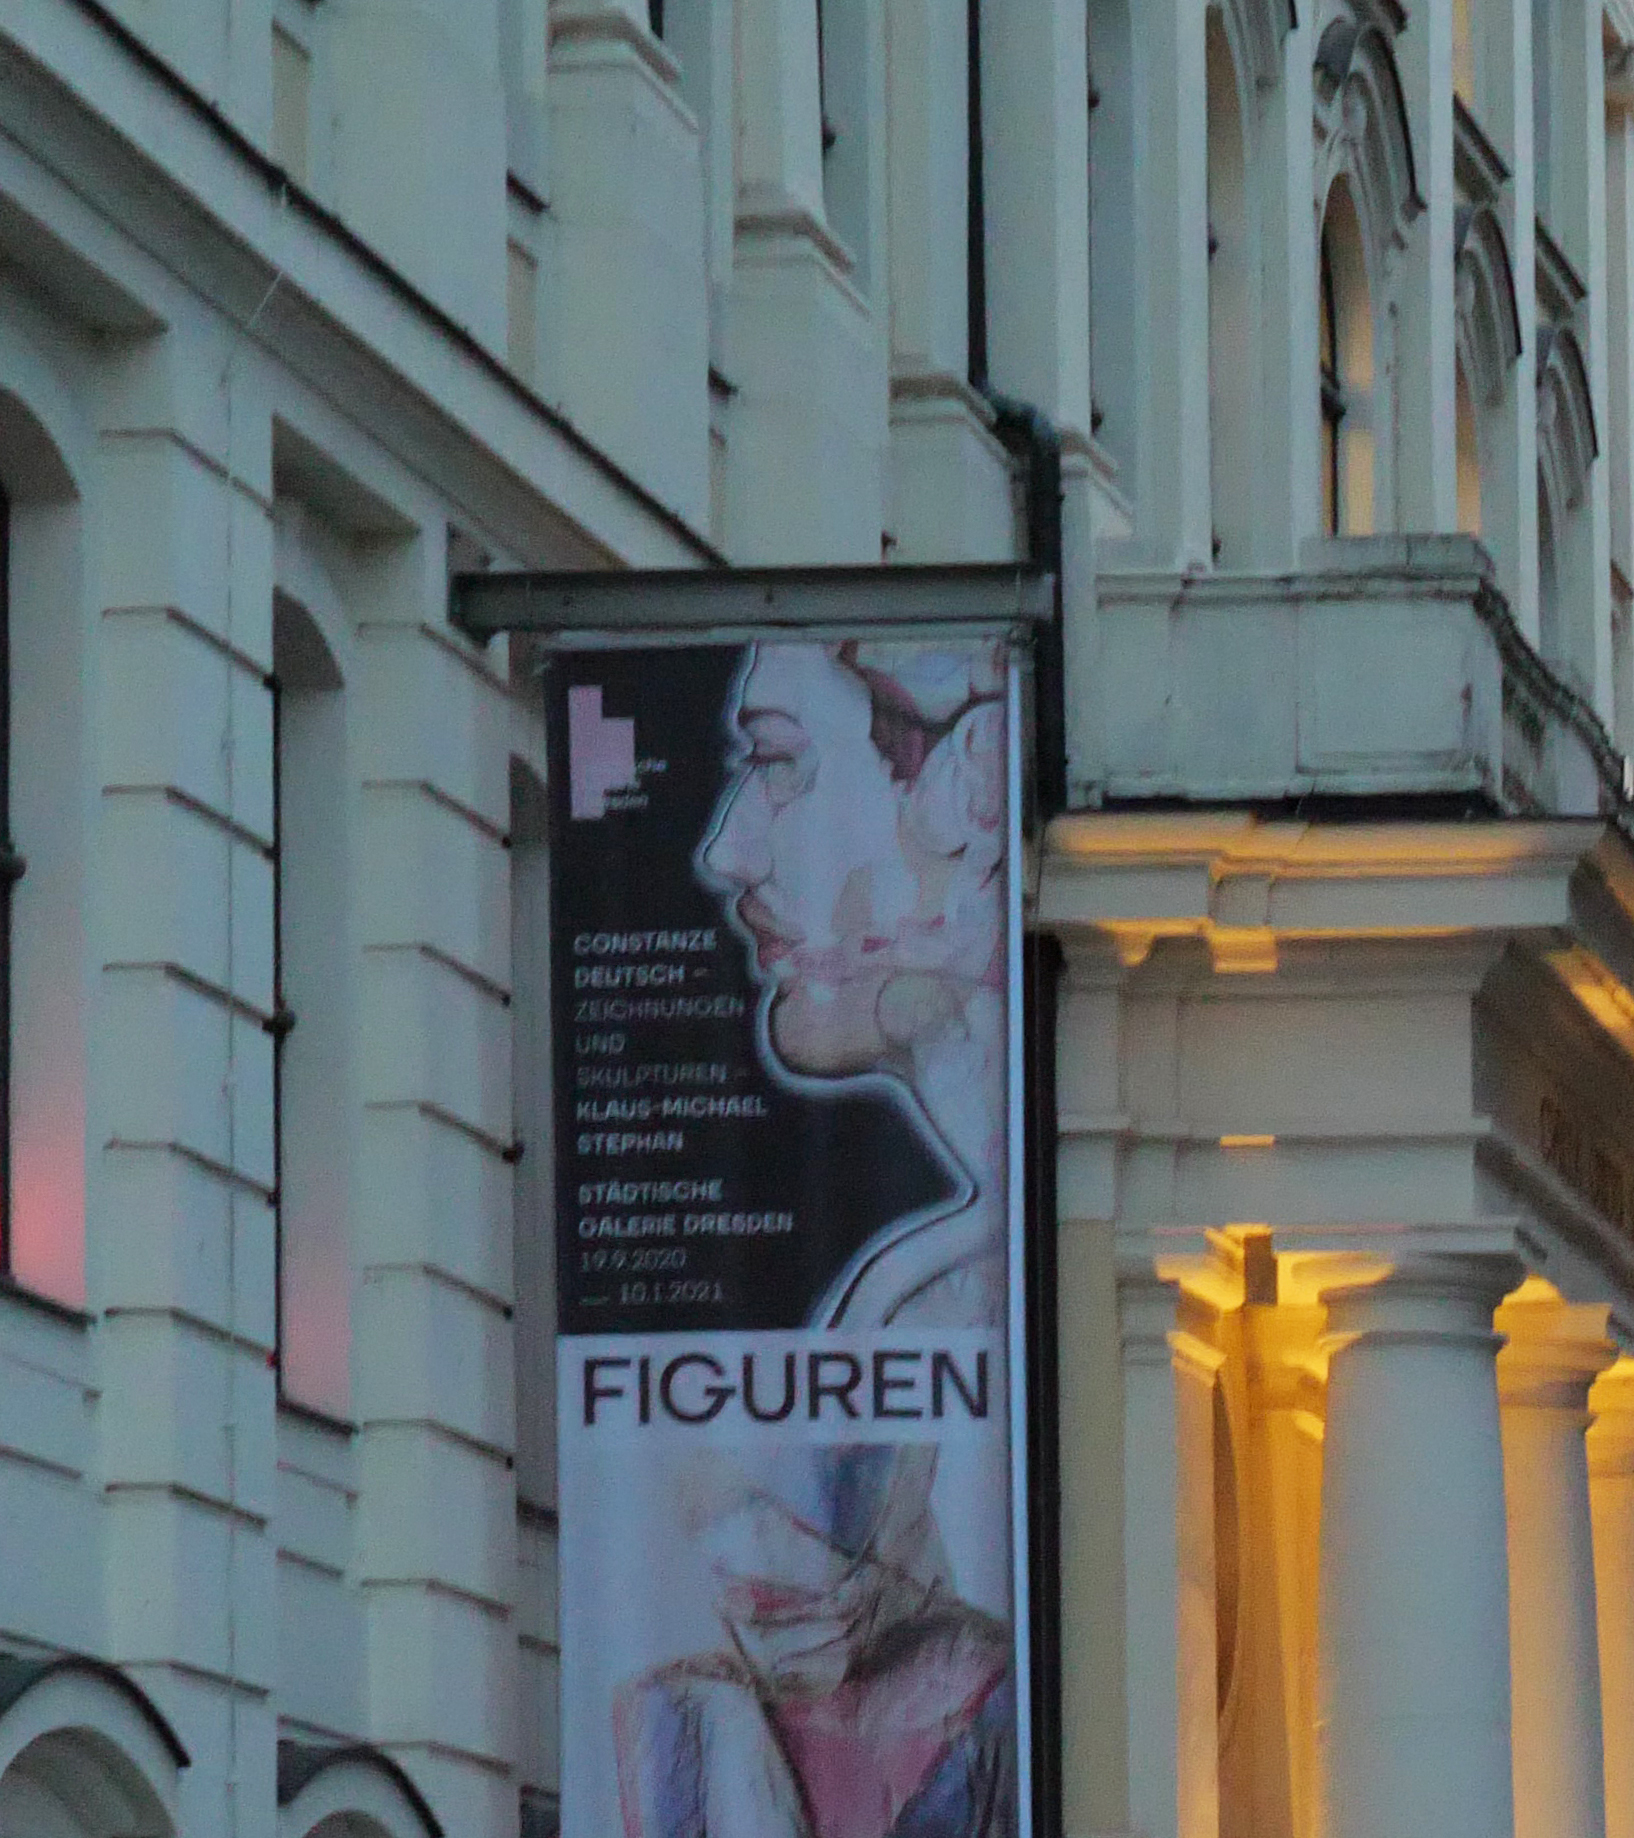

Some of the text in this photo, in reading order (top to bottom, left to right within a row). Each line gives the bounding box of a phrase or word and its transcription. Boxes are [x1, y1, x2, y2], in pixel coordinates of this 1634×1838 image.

[574, 928, 718, 955] CONSTANZE
[575, 964, 685, 988] DEUTSCH
[575, 997, 745, 1022] ZEICHNUNGEN
[576, 1032, 626, 1055] UND
[577, 1063, 728, 1089] SKULPTUREN
[577, 1095, 768, 1121] KLAUS-MICHAEL
[577, 1130, 684, 1156] STEPHAN
[579, 1178, 724, 1205] STÄDTISCHE
[579, 1211, 794, 1239] GALERIE DRESDEN
[583, 1350, 988, 1428] FIGUREN
